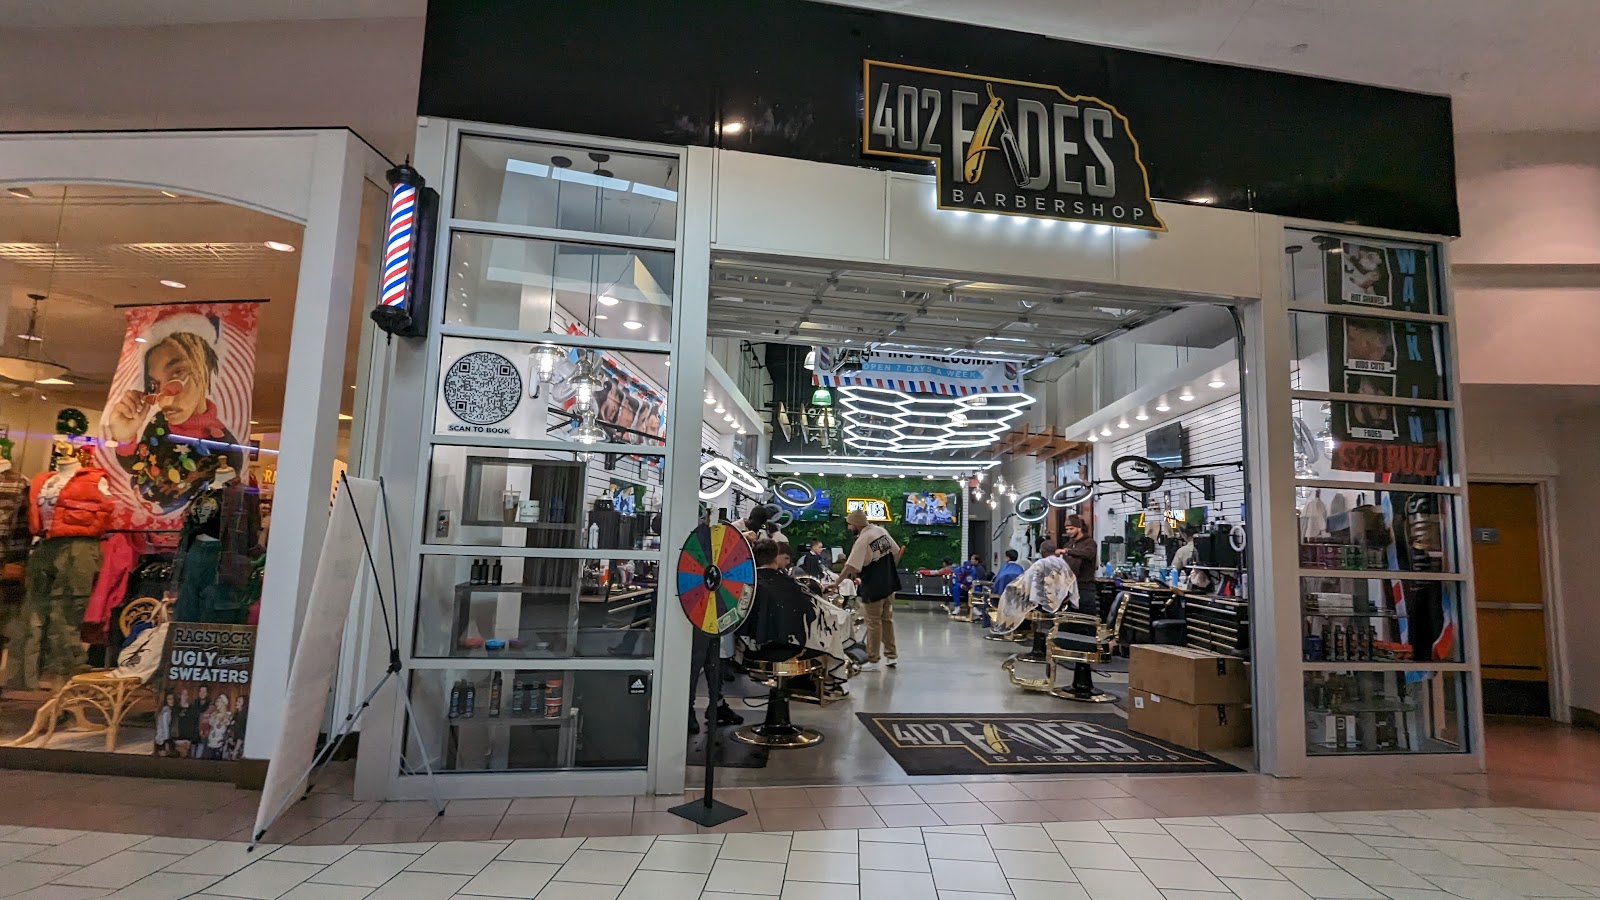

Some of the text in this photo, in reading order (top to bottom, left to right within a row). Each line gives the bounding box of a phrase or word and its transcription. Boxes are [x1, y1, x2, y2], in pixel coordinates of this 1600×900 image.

[872, 82, 1116, 198] 402 FADES
[952, 189, 1145, 221] BARBERSHOP
[862, 363, 891, 371] OPEN
[906, 365, 932, 373] DAYS
[946, 370, 977, 378] WEEK
[1369, 361, 1385, 371] CUTS
[1363, 428, 1383, 439] FADES
[175, 630, 251, 644] RAGSTOCK
[172, 651, 217, 666] UGLY
[169, 667, 248, 683] SWEATERS
[891, 720, 1140, 755] 402 FADES
[994, 754, 1181, 763] BARBERSHOP
